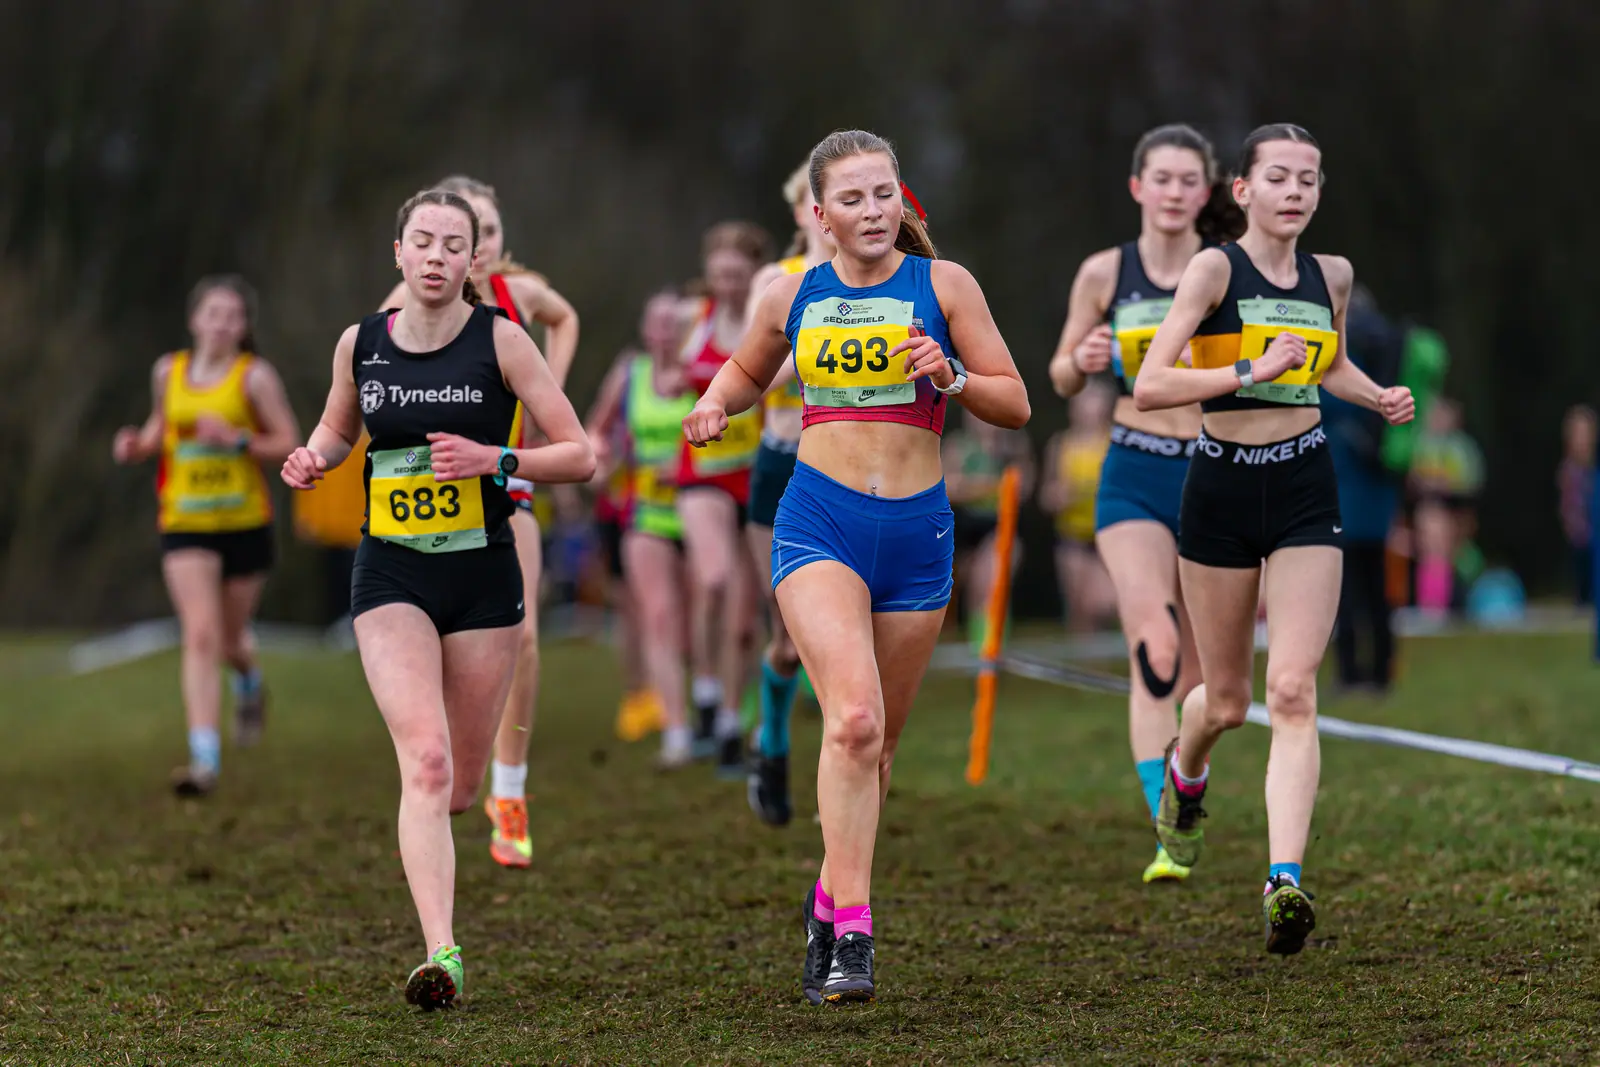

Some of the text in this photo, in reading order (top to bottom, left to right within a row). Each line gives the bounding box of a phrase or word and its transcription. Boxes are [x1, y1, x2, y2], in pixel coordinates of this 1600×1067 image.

[823, 315, 885, 325] SEDGEFIELD
[815, 336, 889, 374] 493
[388, 385, 483, 407] Tynedale
[862, 389, 876, 397] RUN
[1233, 440, 1296, 464] NIKE
[1298, 426, 1327, 454] PR
[394, 464, 431, 474] SEDGEF
[389, 485, 461, 522] 683
